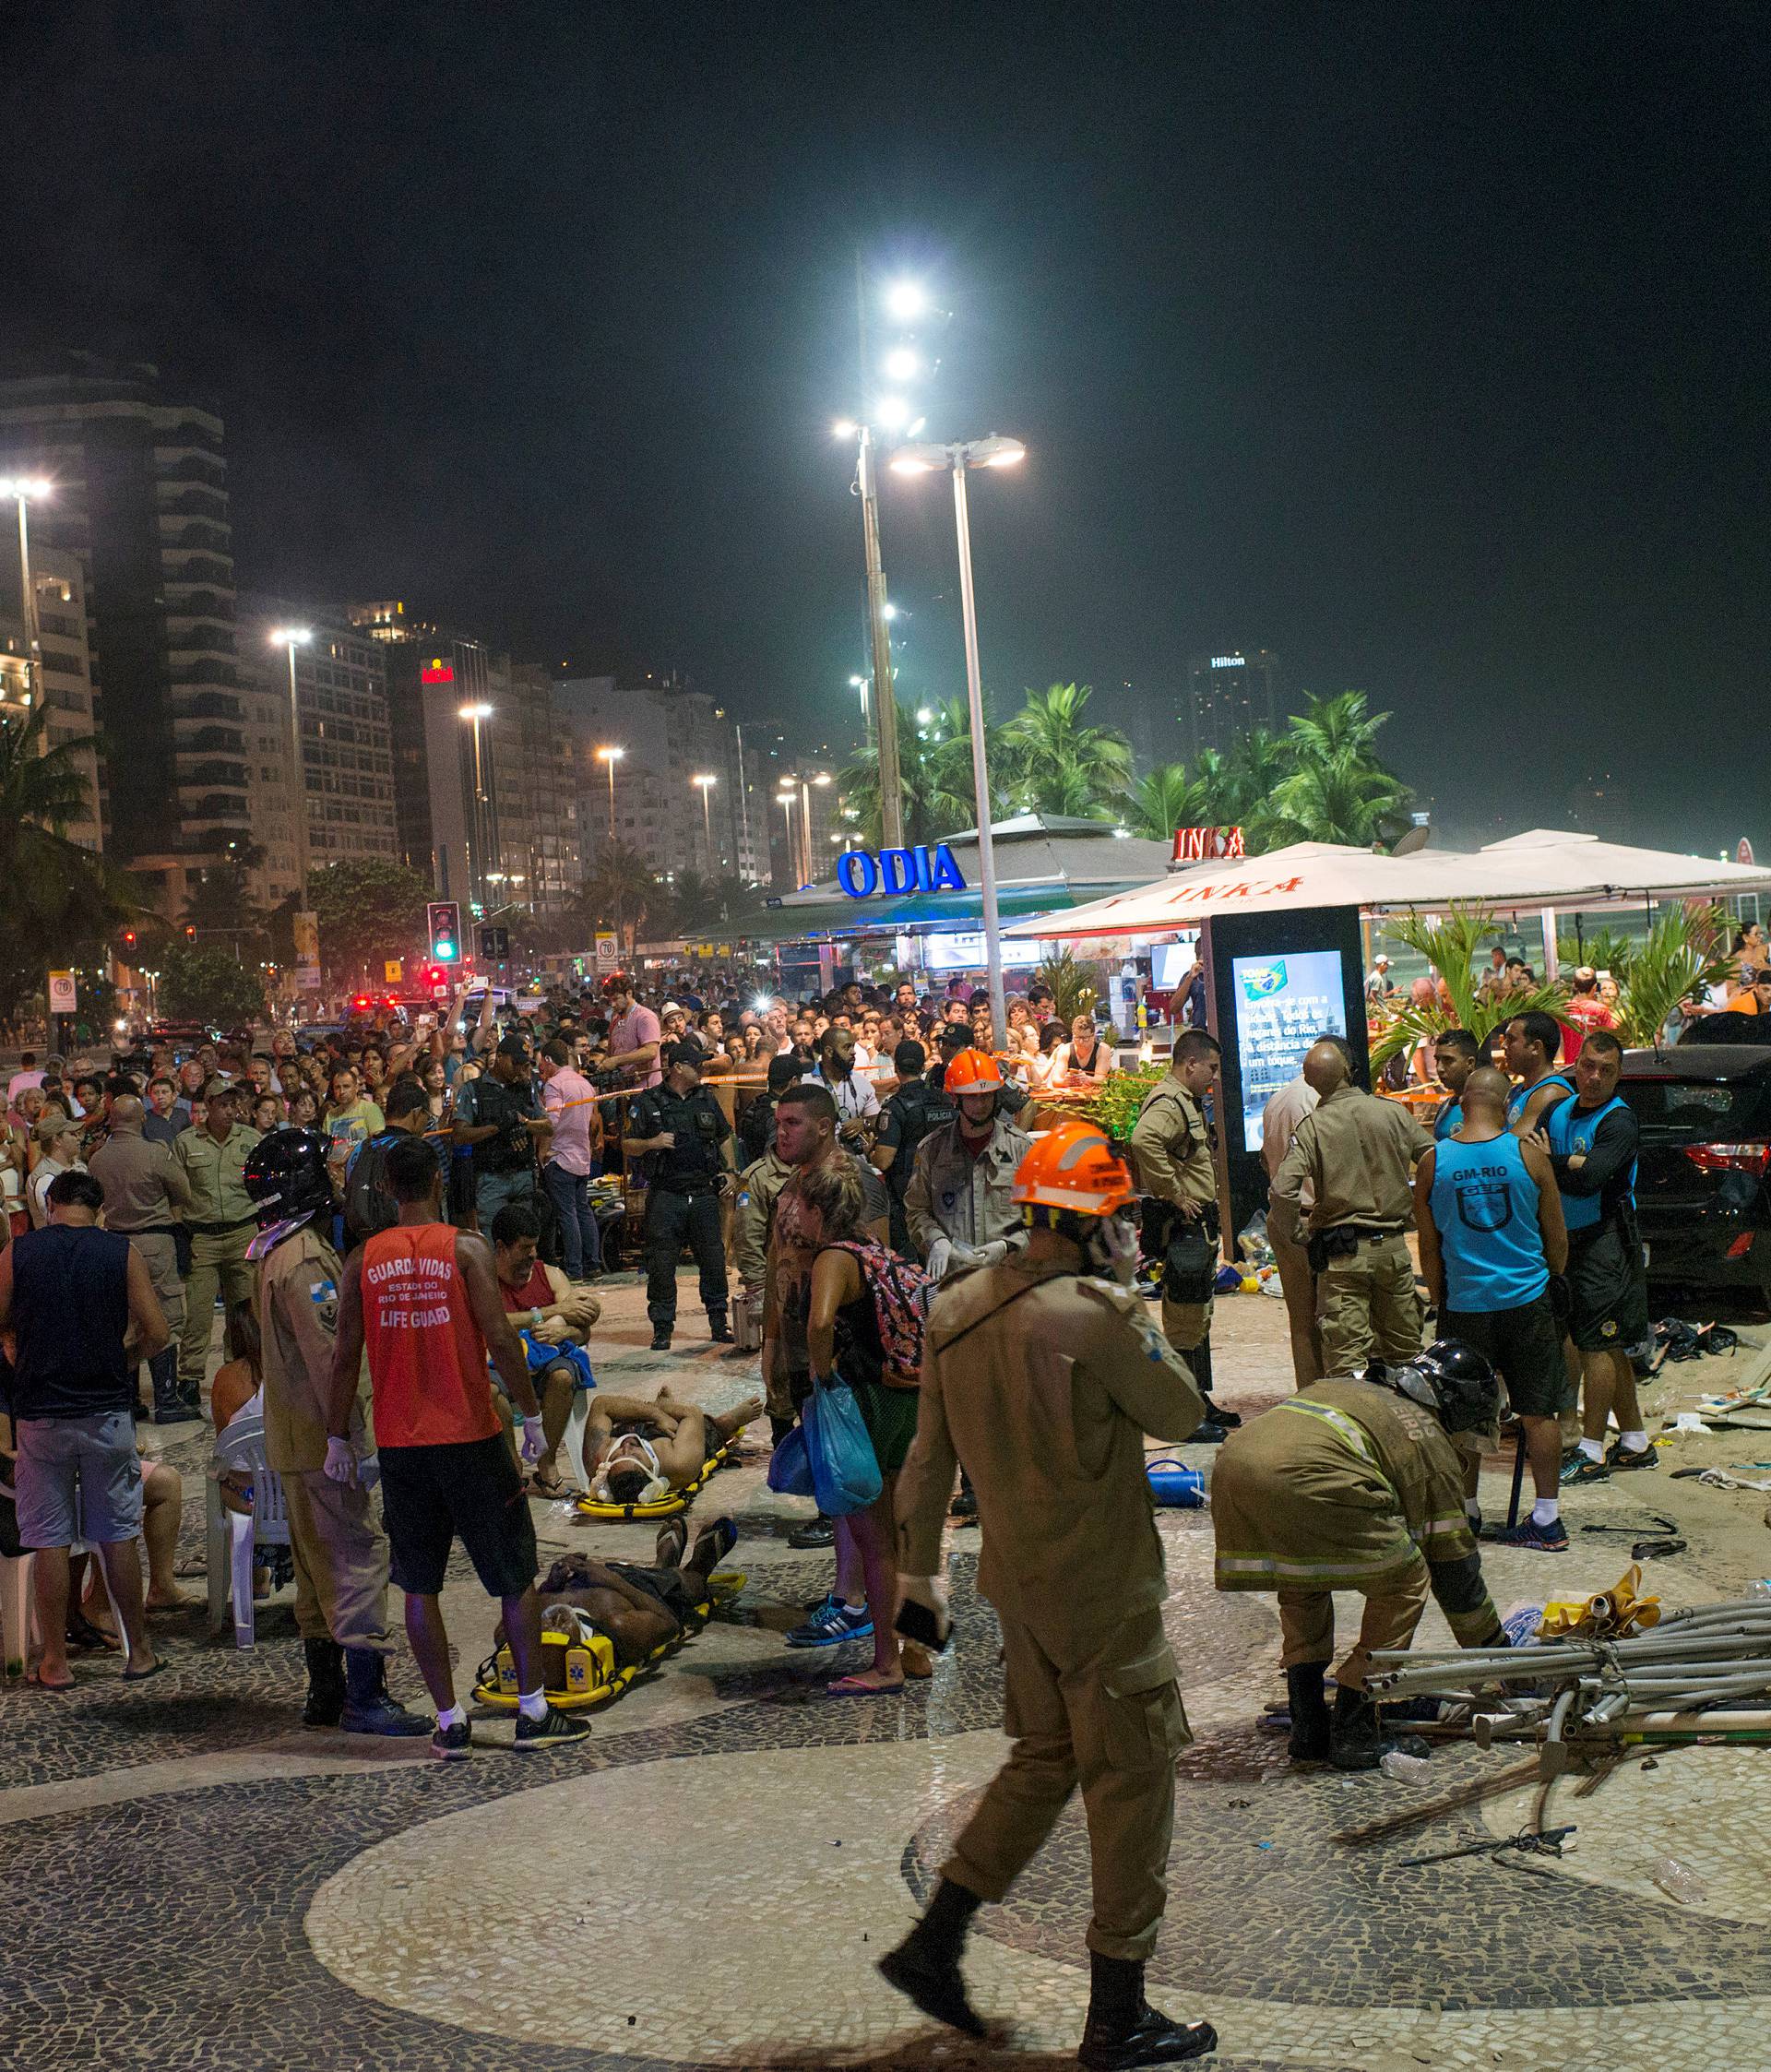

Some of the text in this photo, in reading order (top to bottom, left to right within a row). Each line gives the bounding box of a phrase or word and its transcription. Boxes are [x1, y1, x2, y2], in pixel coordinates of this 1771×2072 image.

[1211, 657, 1245, 668] Hilton
[1172, 826, 1245, 862] INKA
[1164, 876, 1305, 904] INKA
[603, 944, 612, 953] 70
[1298, 996, 1318, 1005] com
[1321, 995, 1328, 1004] a
[1281, 1009, 1309, 1020] Todos
[1284, 1025, 1296, 1035] do
[1249, 1058, 1265, 1066] um
[1453, 1166, 1507, 1181] GM-RIO
[419, 1257, 452, 1280] VIDAS
[388, 1281, 438, 1292] ESTAD DO
[378, 1293, 396, 1304] RIO
[398, 1292, 410, 1301] DE
[380, 1306, 450, 1328] LIFE GUARD
